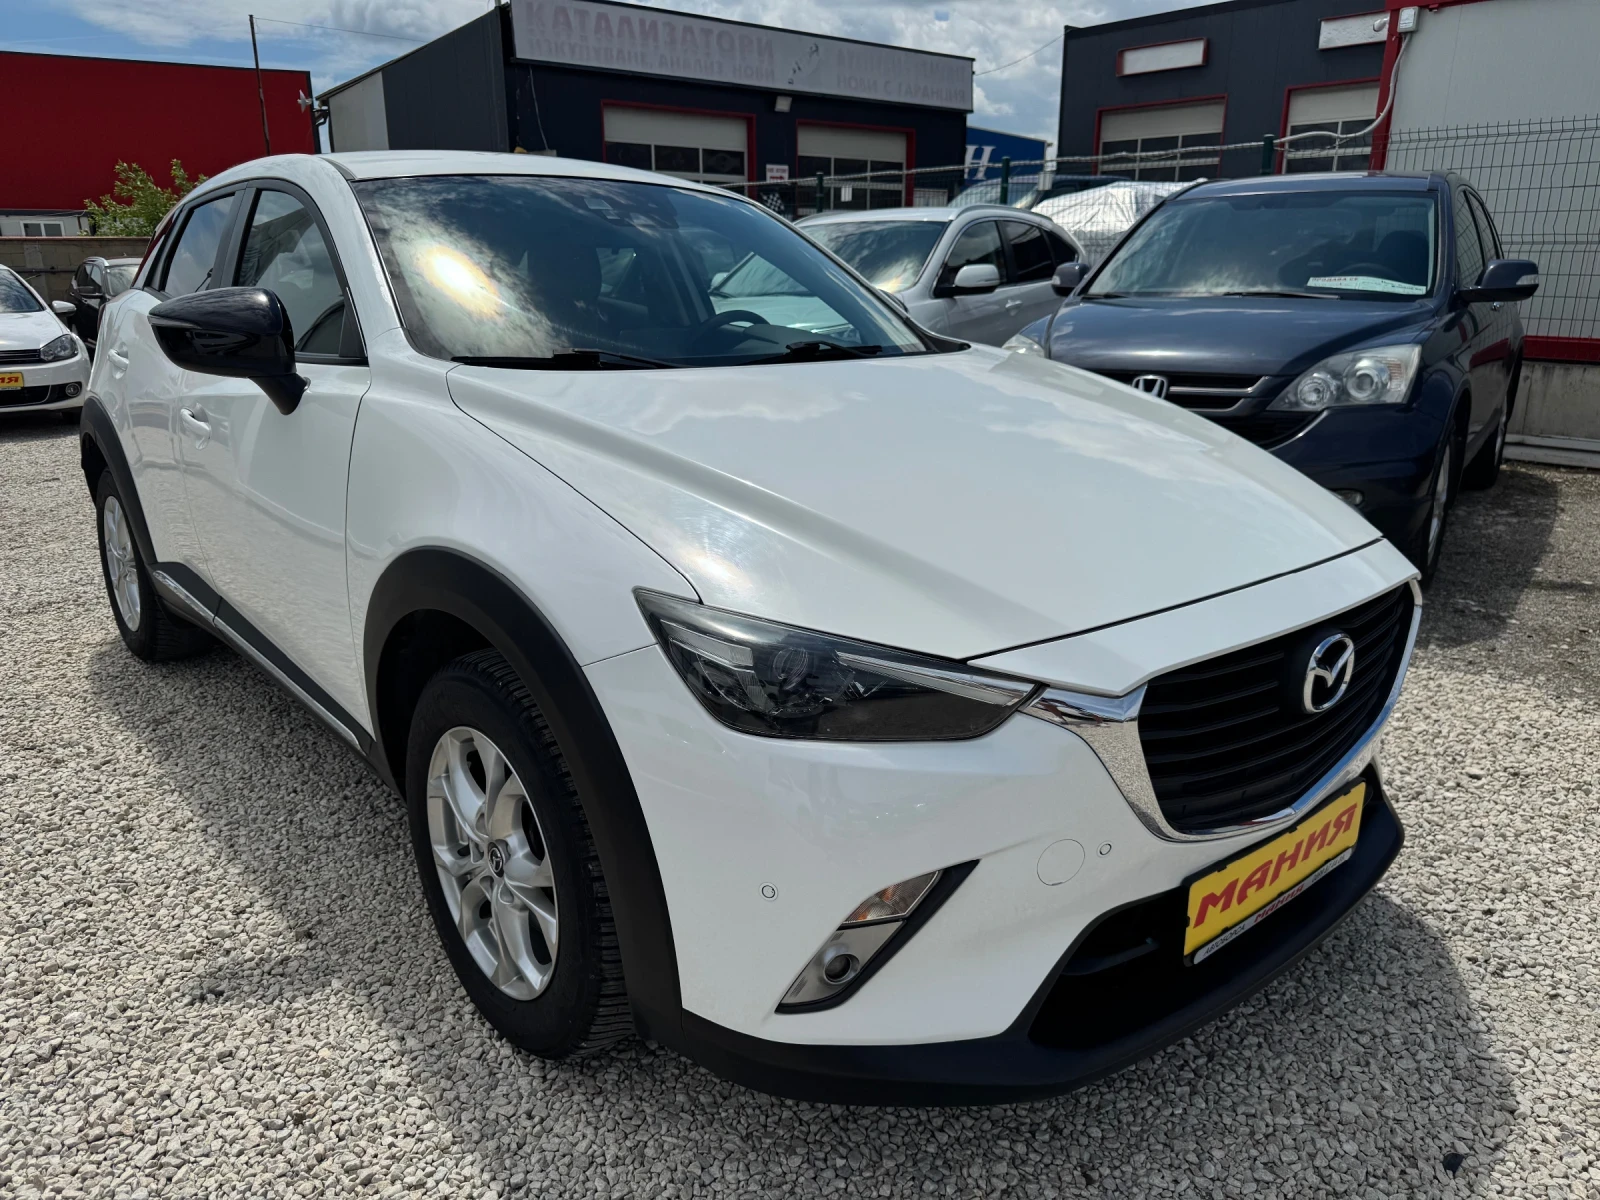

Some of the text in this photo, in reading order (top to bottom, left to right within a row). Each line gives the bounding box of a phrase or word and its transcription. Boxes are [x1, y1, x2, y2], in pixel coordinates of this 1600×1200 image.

[525, 1, 774, 65] КАТАЛИЗАТОРИ
[898, 82, 965, 103] ГАРАНЦИЯ
[1192, 802, 1358, 929] МАНИЯ
[1254, 884, 1304, 923] МАНИЯ
